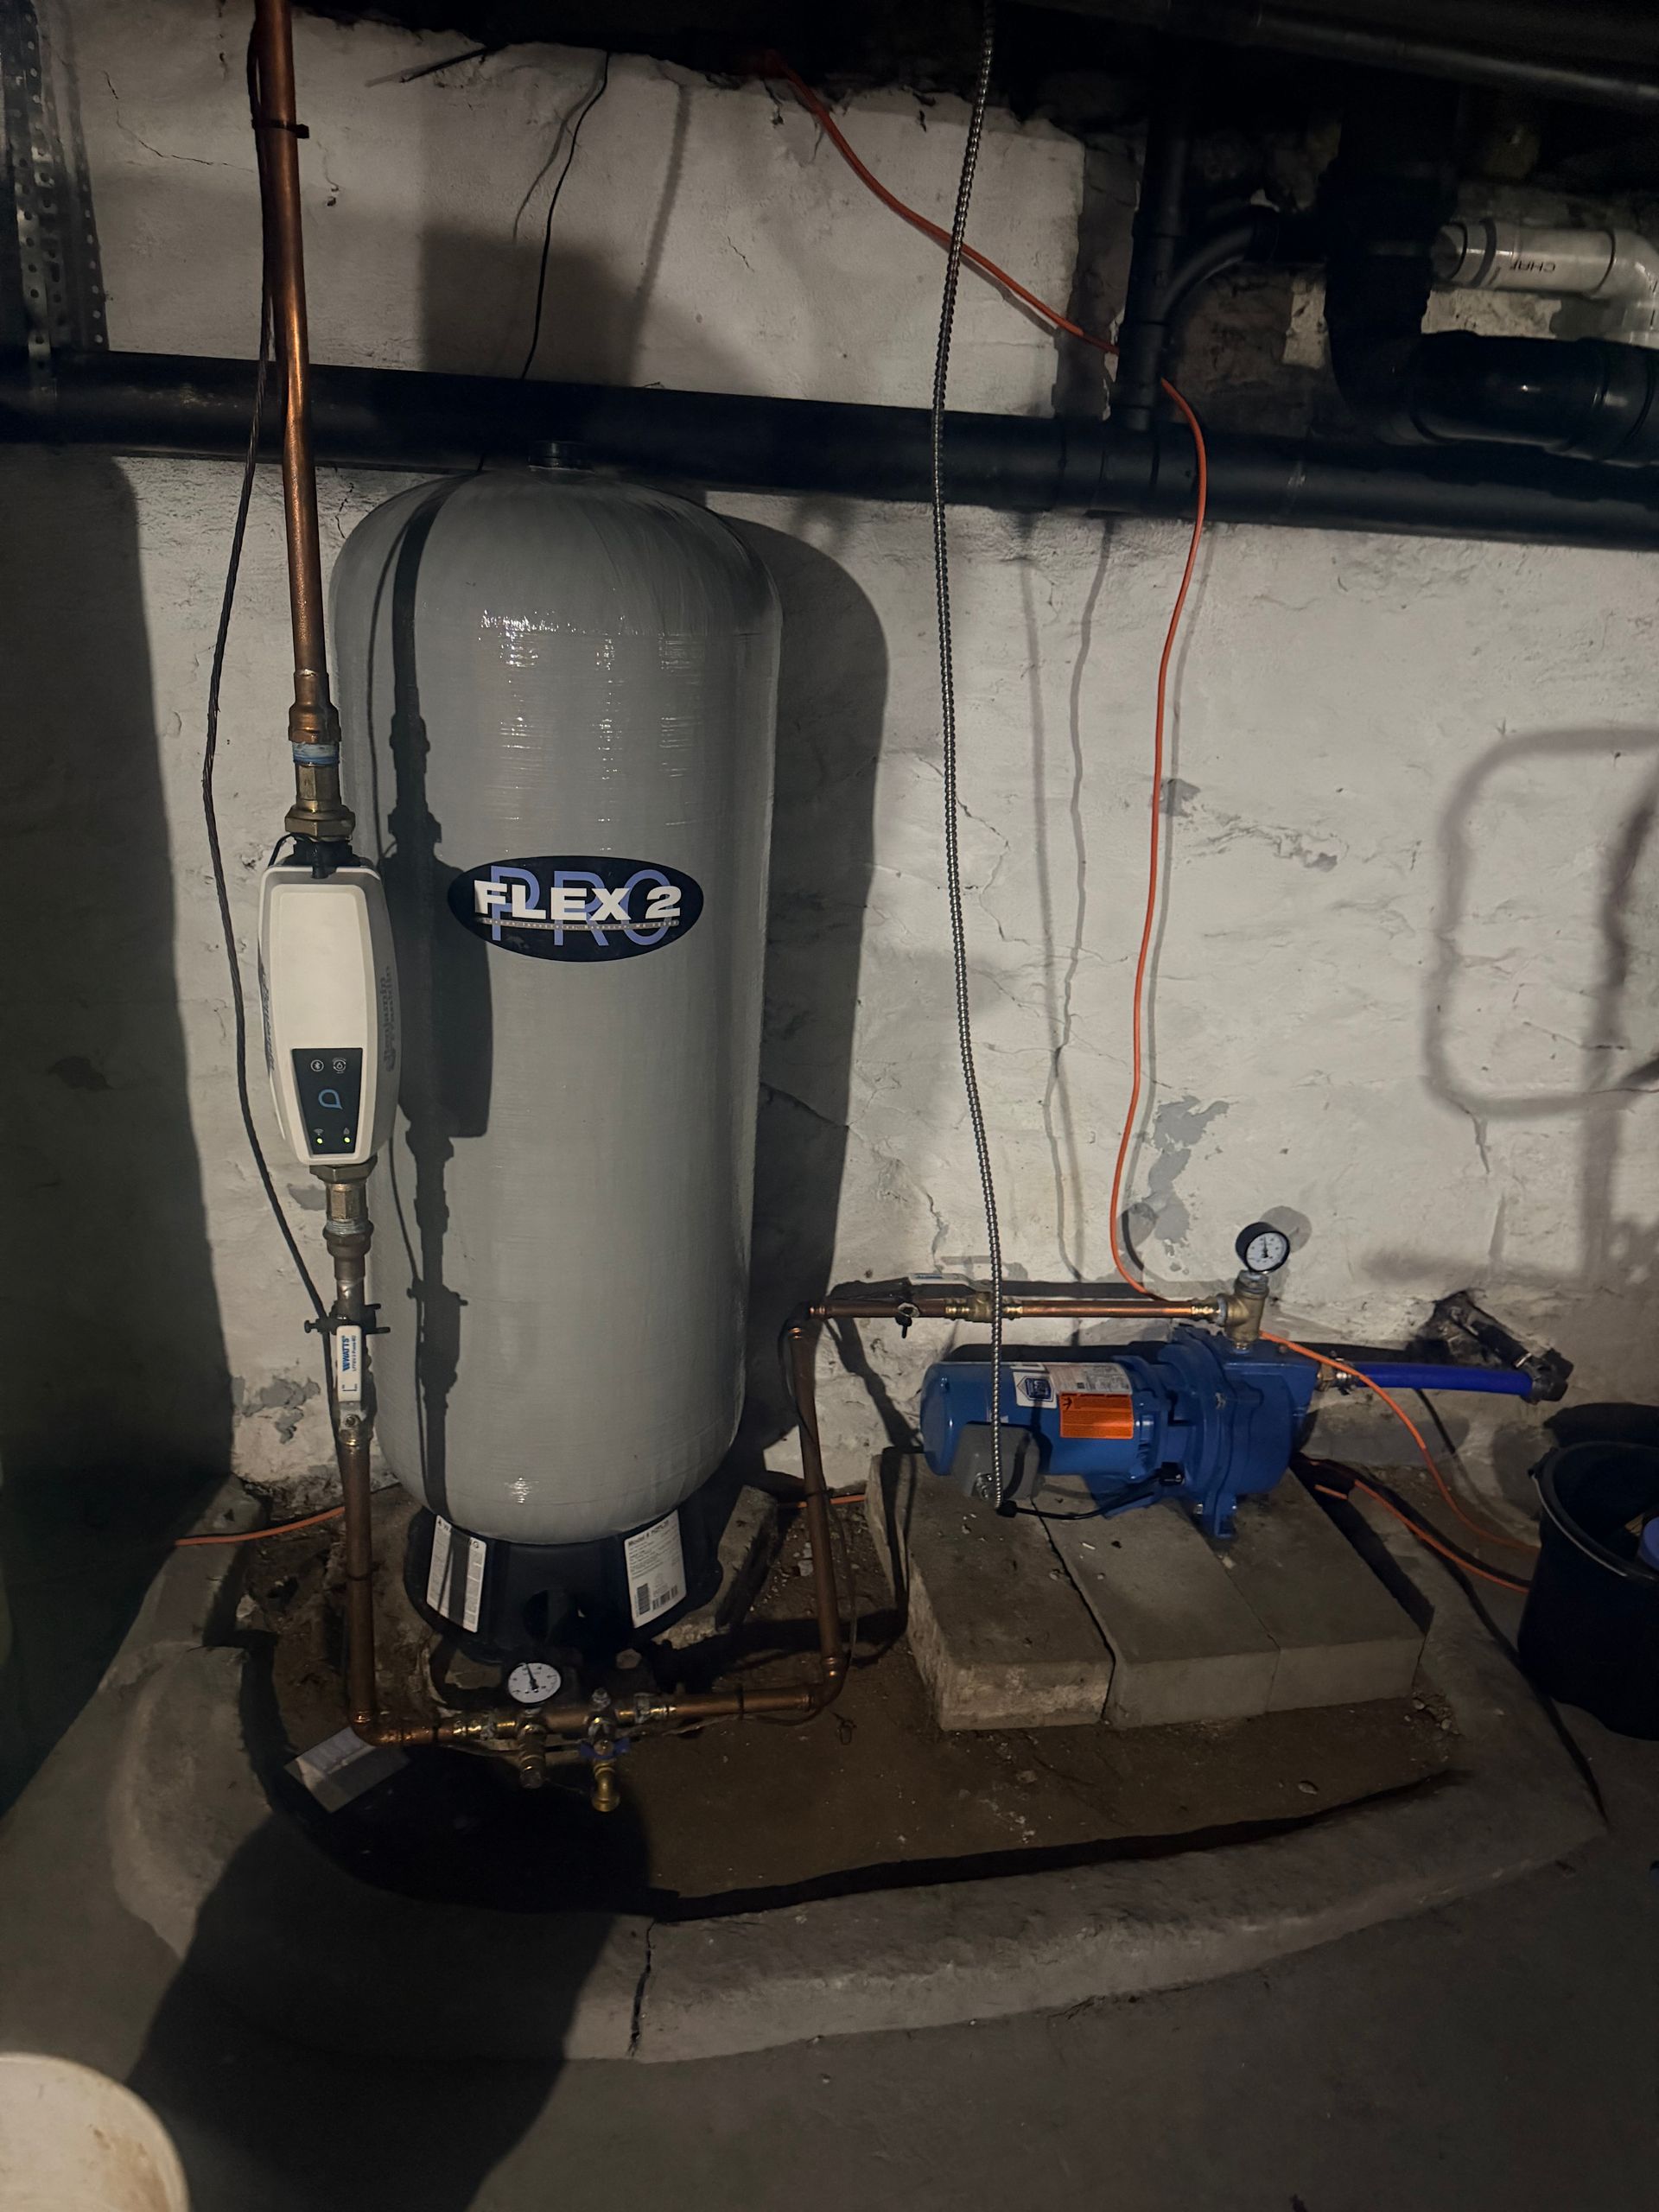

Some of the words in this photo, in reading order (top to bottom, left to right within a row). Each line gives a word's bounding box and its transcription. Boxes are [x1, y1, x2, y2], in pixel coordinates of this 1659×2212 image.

[474, 880, 632, 921] FLEX
[645, 885, 683, 919] 2
[491, 865, 671, 946] PRO
